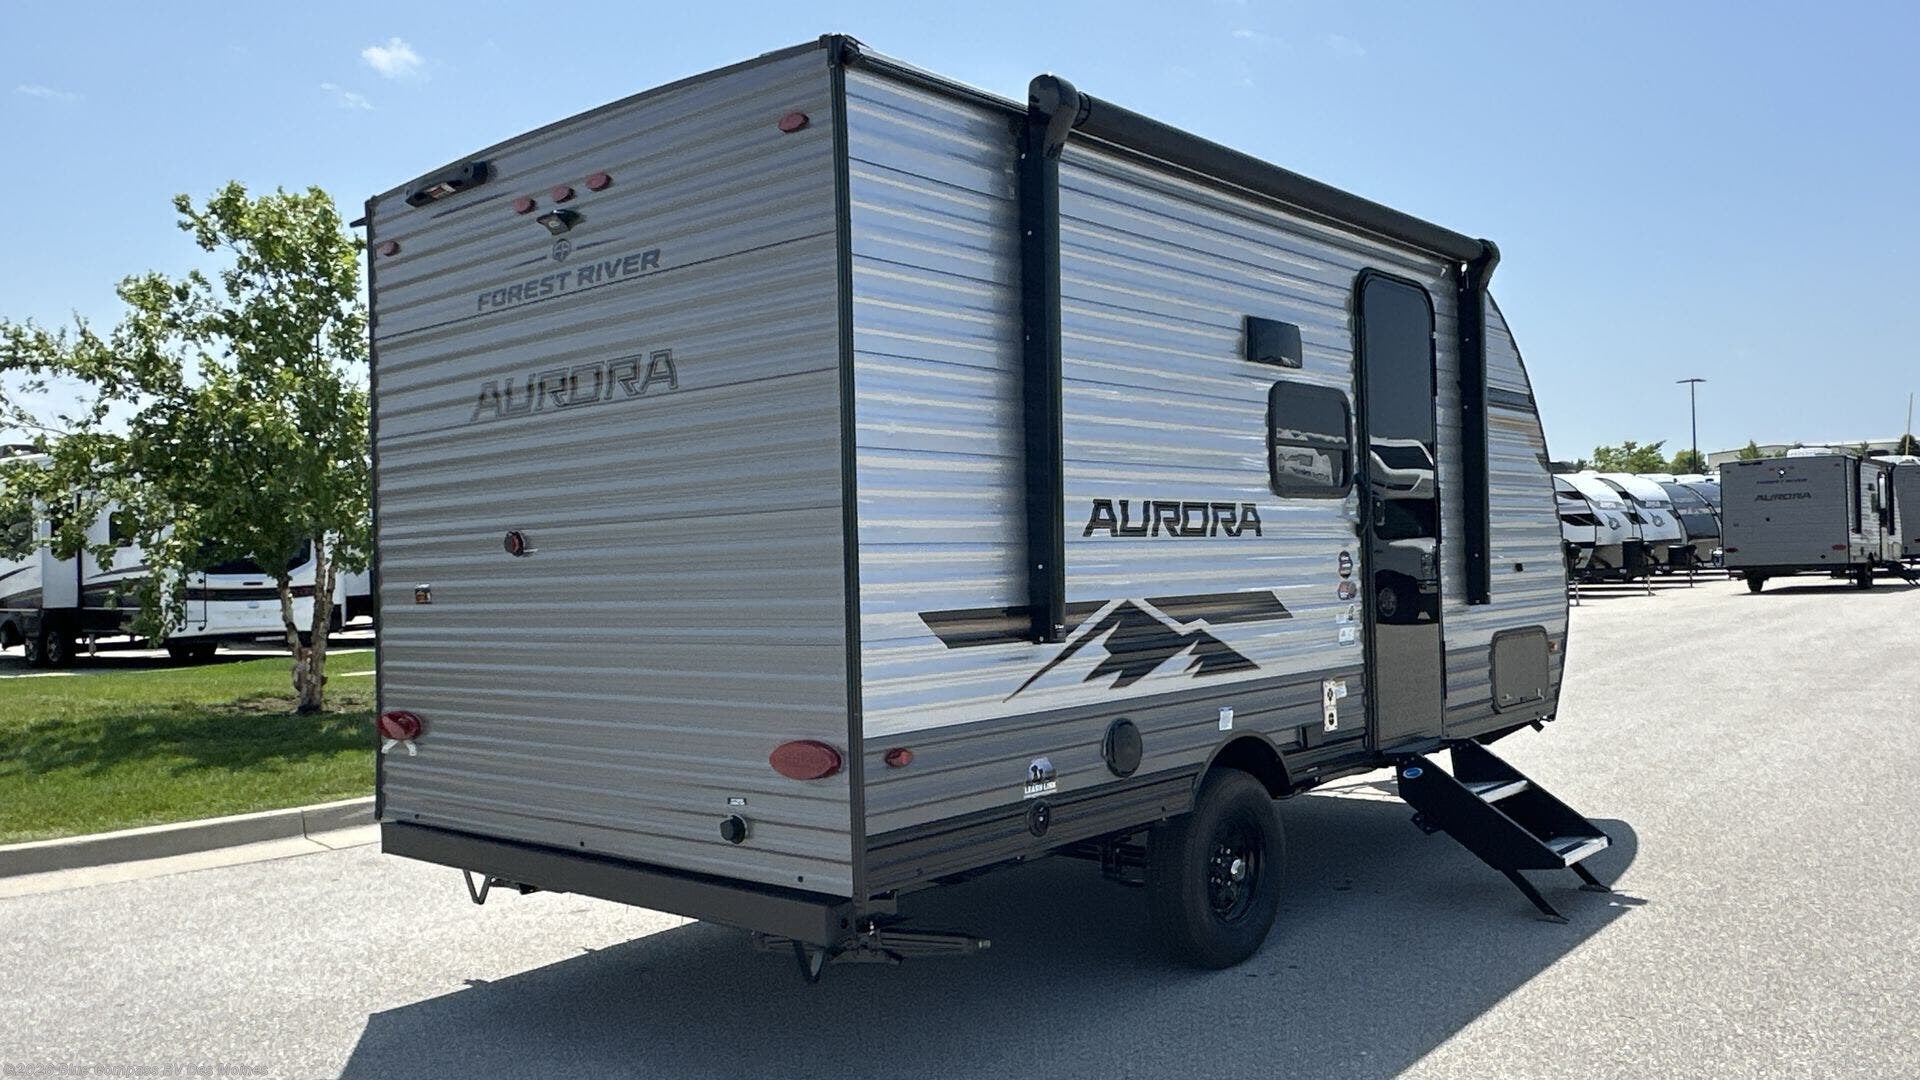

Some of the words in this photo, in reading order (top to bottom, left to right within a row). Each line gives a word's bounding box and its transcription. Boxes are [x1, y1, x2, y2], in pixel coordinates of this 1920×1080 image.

[477, 271, 572, 312] FOREST
[577, 248, 661, 285] RIVER
[470, 348, 679, 422] AURORA
[1082, 498, 1262, 537] AURORA
[1754, 492, 1812, 502] AURORA
